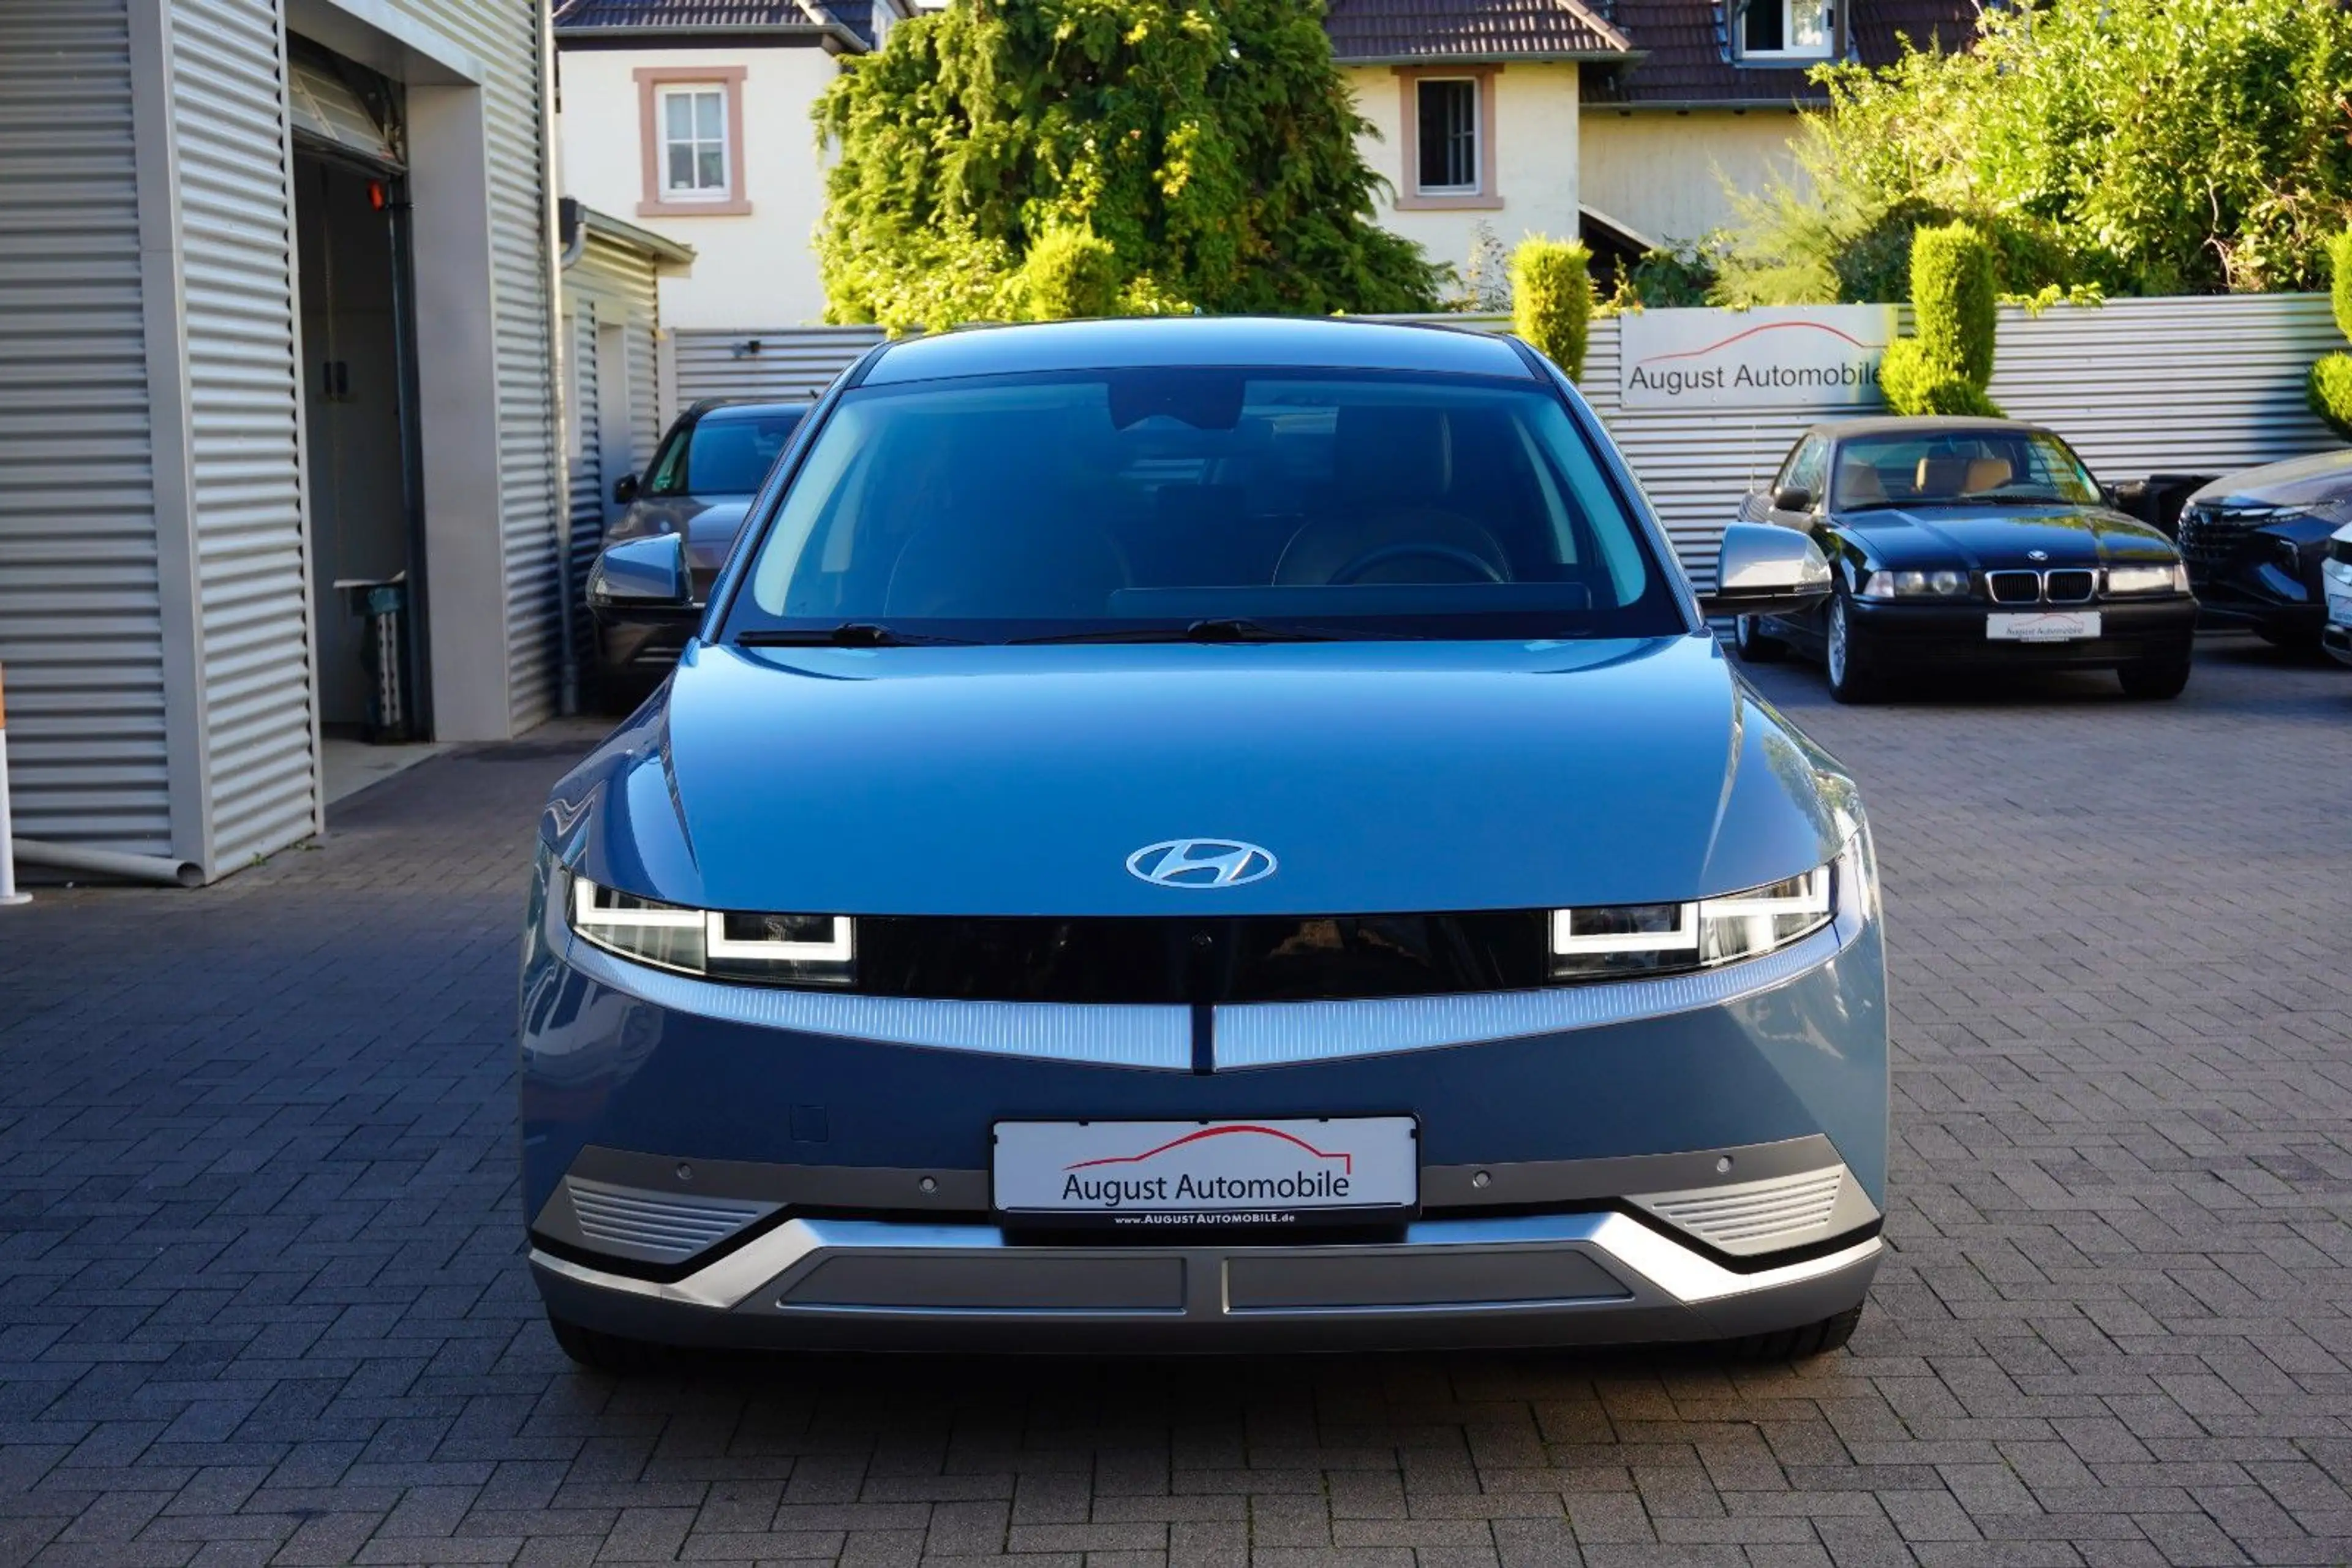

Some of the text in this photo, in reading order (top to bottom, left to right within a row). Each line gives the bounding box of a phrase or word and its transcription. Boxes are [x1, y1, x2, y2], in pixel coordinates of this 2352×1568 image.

[1629, 366, 1724, 395] August
[1062, 1170, 1349, 1207] August Automobile
